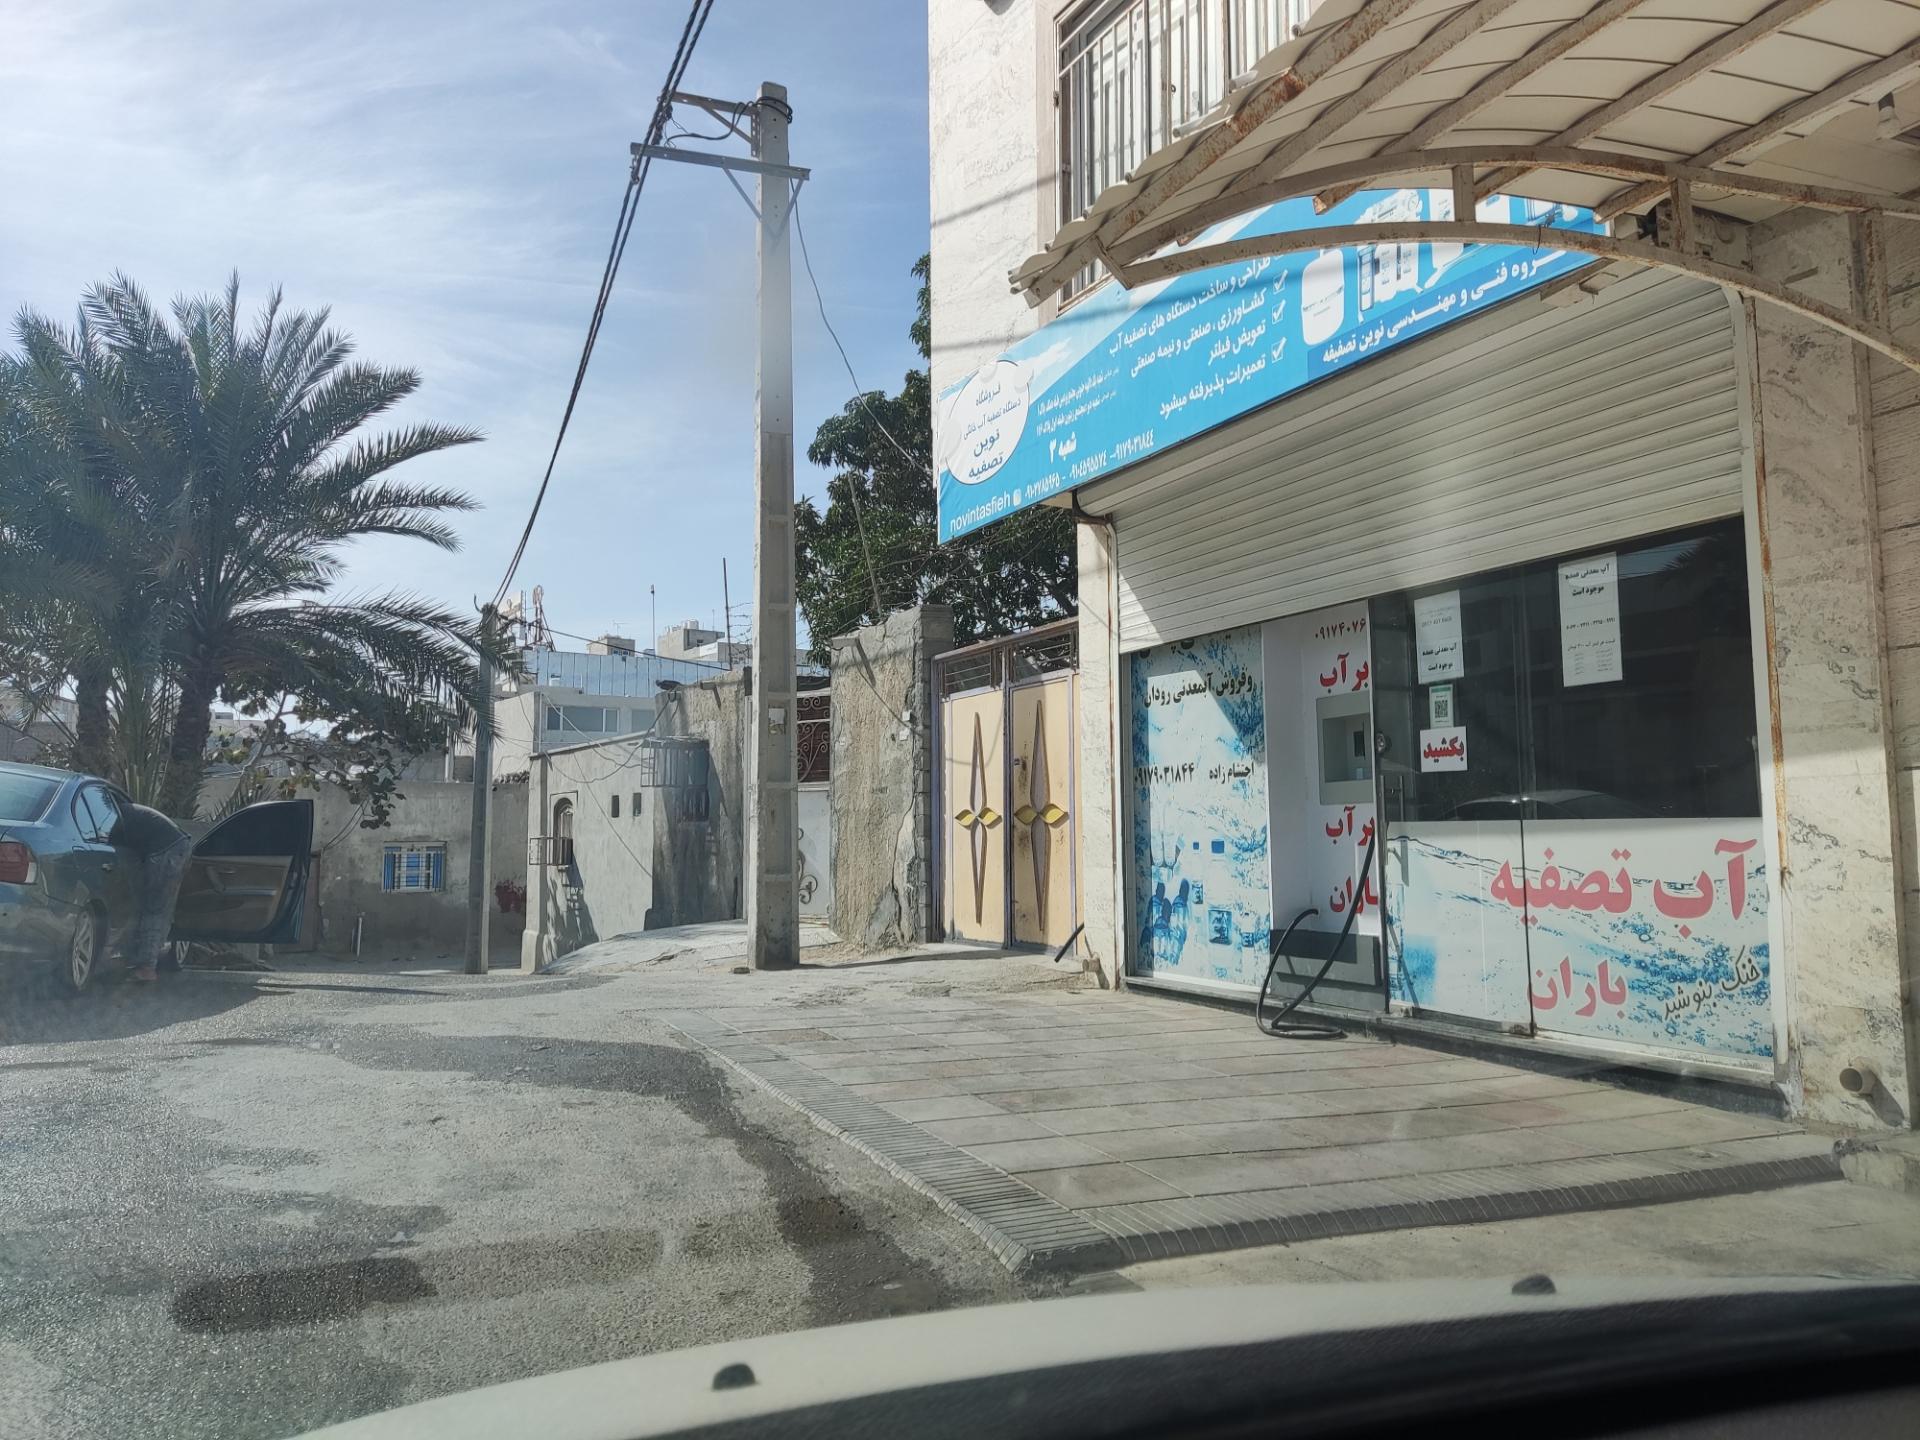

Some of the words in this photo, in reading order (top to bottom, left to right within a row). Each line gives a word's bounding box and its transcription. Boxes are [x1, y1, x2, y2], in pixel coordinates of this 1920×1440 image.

[1511, 250, 1566, 280] روه
[1198, 280, 1229, 305] ساخت
[1471, 262, 1508, 299] فنی
[1166, 298, 1197, 322] دستگاه
[1460, 288, 1468, 306] و
[1148, 314, 1165, 336] های
[1386, 292, 1456, 339] مهندسی
[1109, 333, 1122, 356] آب
[1123, 321, 1148, 348] تصفیه
[1183, 321, 1211, 351] صنعتی
[1232, 320, 1266, 354] تعویض
[1358, 319, 1385, 352] نوین
[1131, 350, 1156, 378] صنعتی
[1157, 339, 1175, 361] نیمه
[1208, 335, 1231, 366] فیلتر
[1226, 353, 1266, 384] تعمیرات
[1159, 390, 1187, 420] میشود
[973, 428, 1000, 457] نوین
[968, 451, 1004, 480] تصفیه
[949, 490, 1011, 533] novintasfieh
[1319, 652, 1349, 693] آب
[1423, 736, 1465, 763] بکشید
[1209, 763, 1226, 785] زاده
[1326, 805, 1356, 844] آب
[1490, 847, 1633, 927] تصفیه
[1653, 838, 1758, 940] آب
[1721, 944, 1761, 993] خنک
[1526, 955, 1628, 1020] باران
[1662, 976, 1717, 1021] بنوشید
